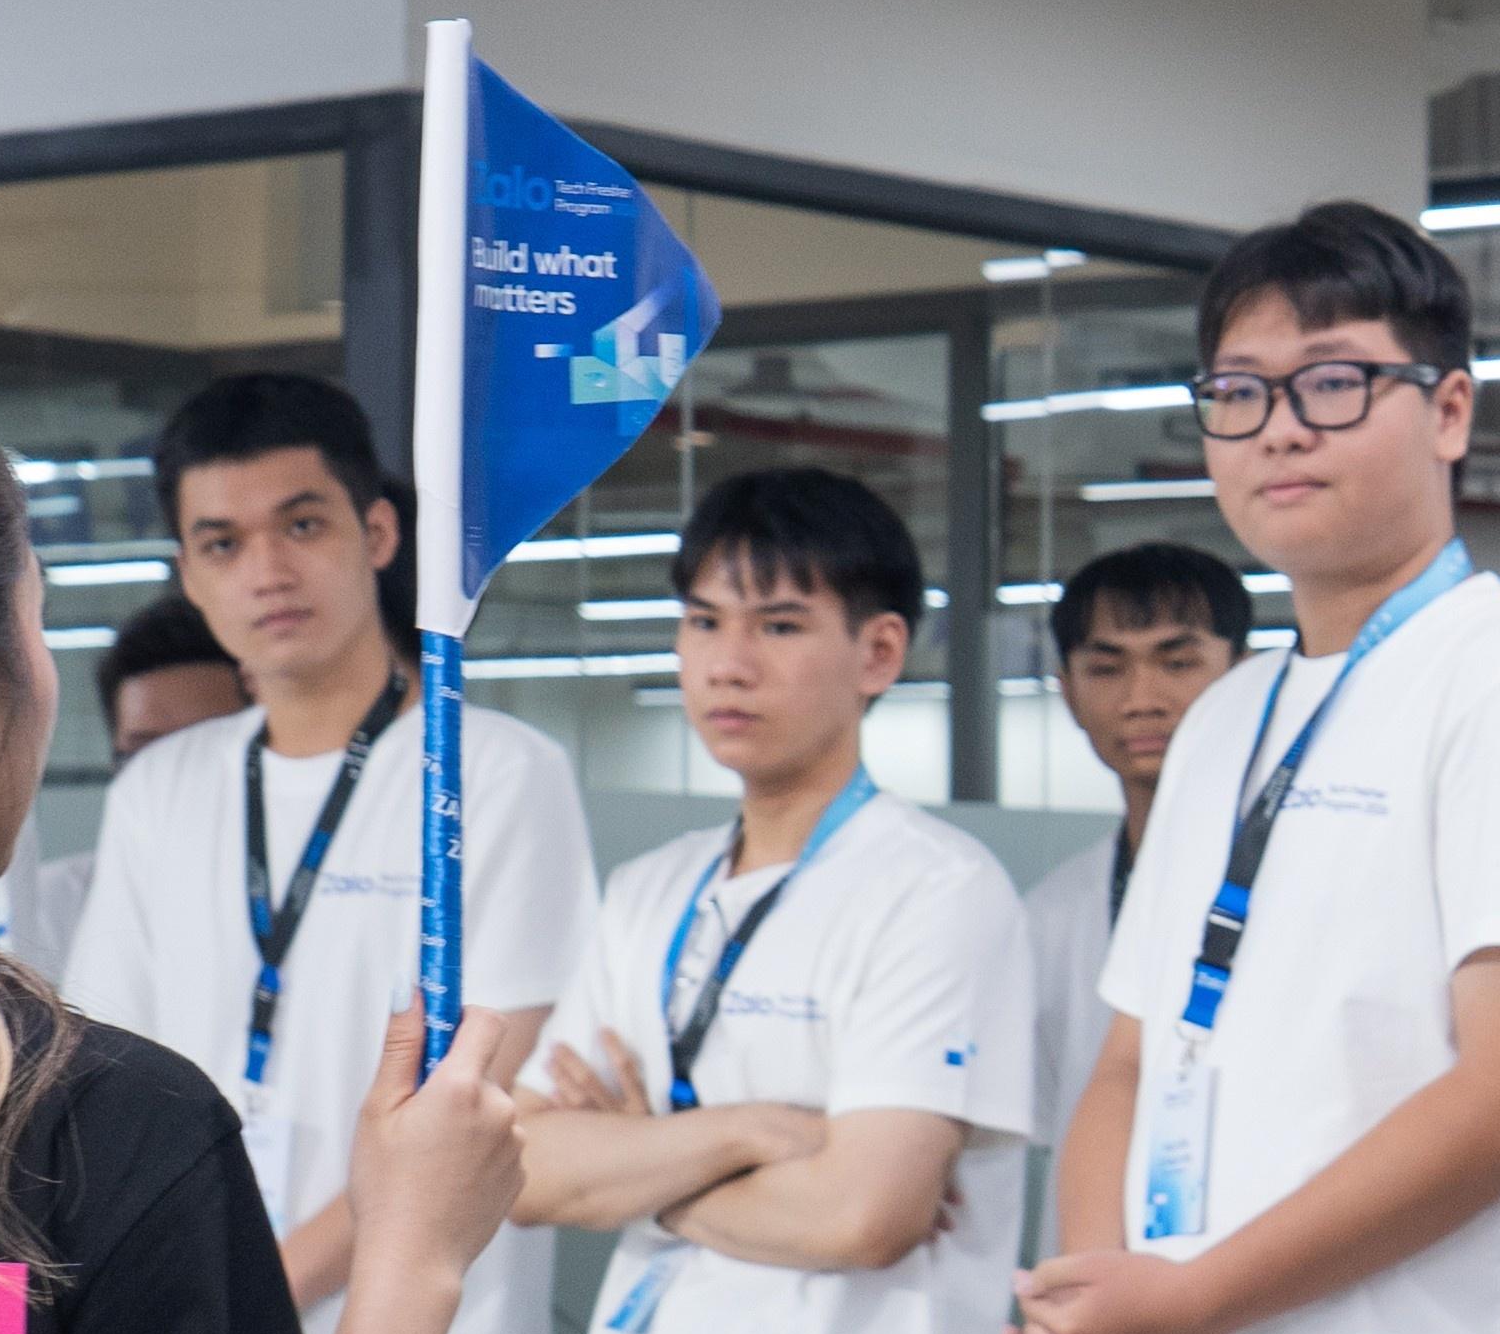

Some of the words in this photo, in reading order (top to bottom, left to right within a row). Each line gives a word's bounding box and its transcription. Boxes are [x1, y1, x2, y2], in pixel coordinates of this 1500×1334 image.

[471, 236, 529, 274] Build
[533, 245, 618, 279] what
[474, 284, 577, 315] matters
